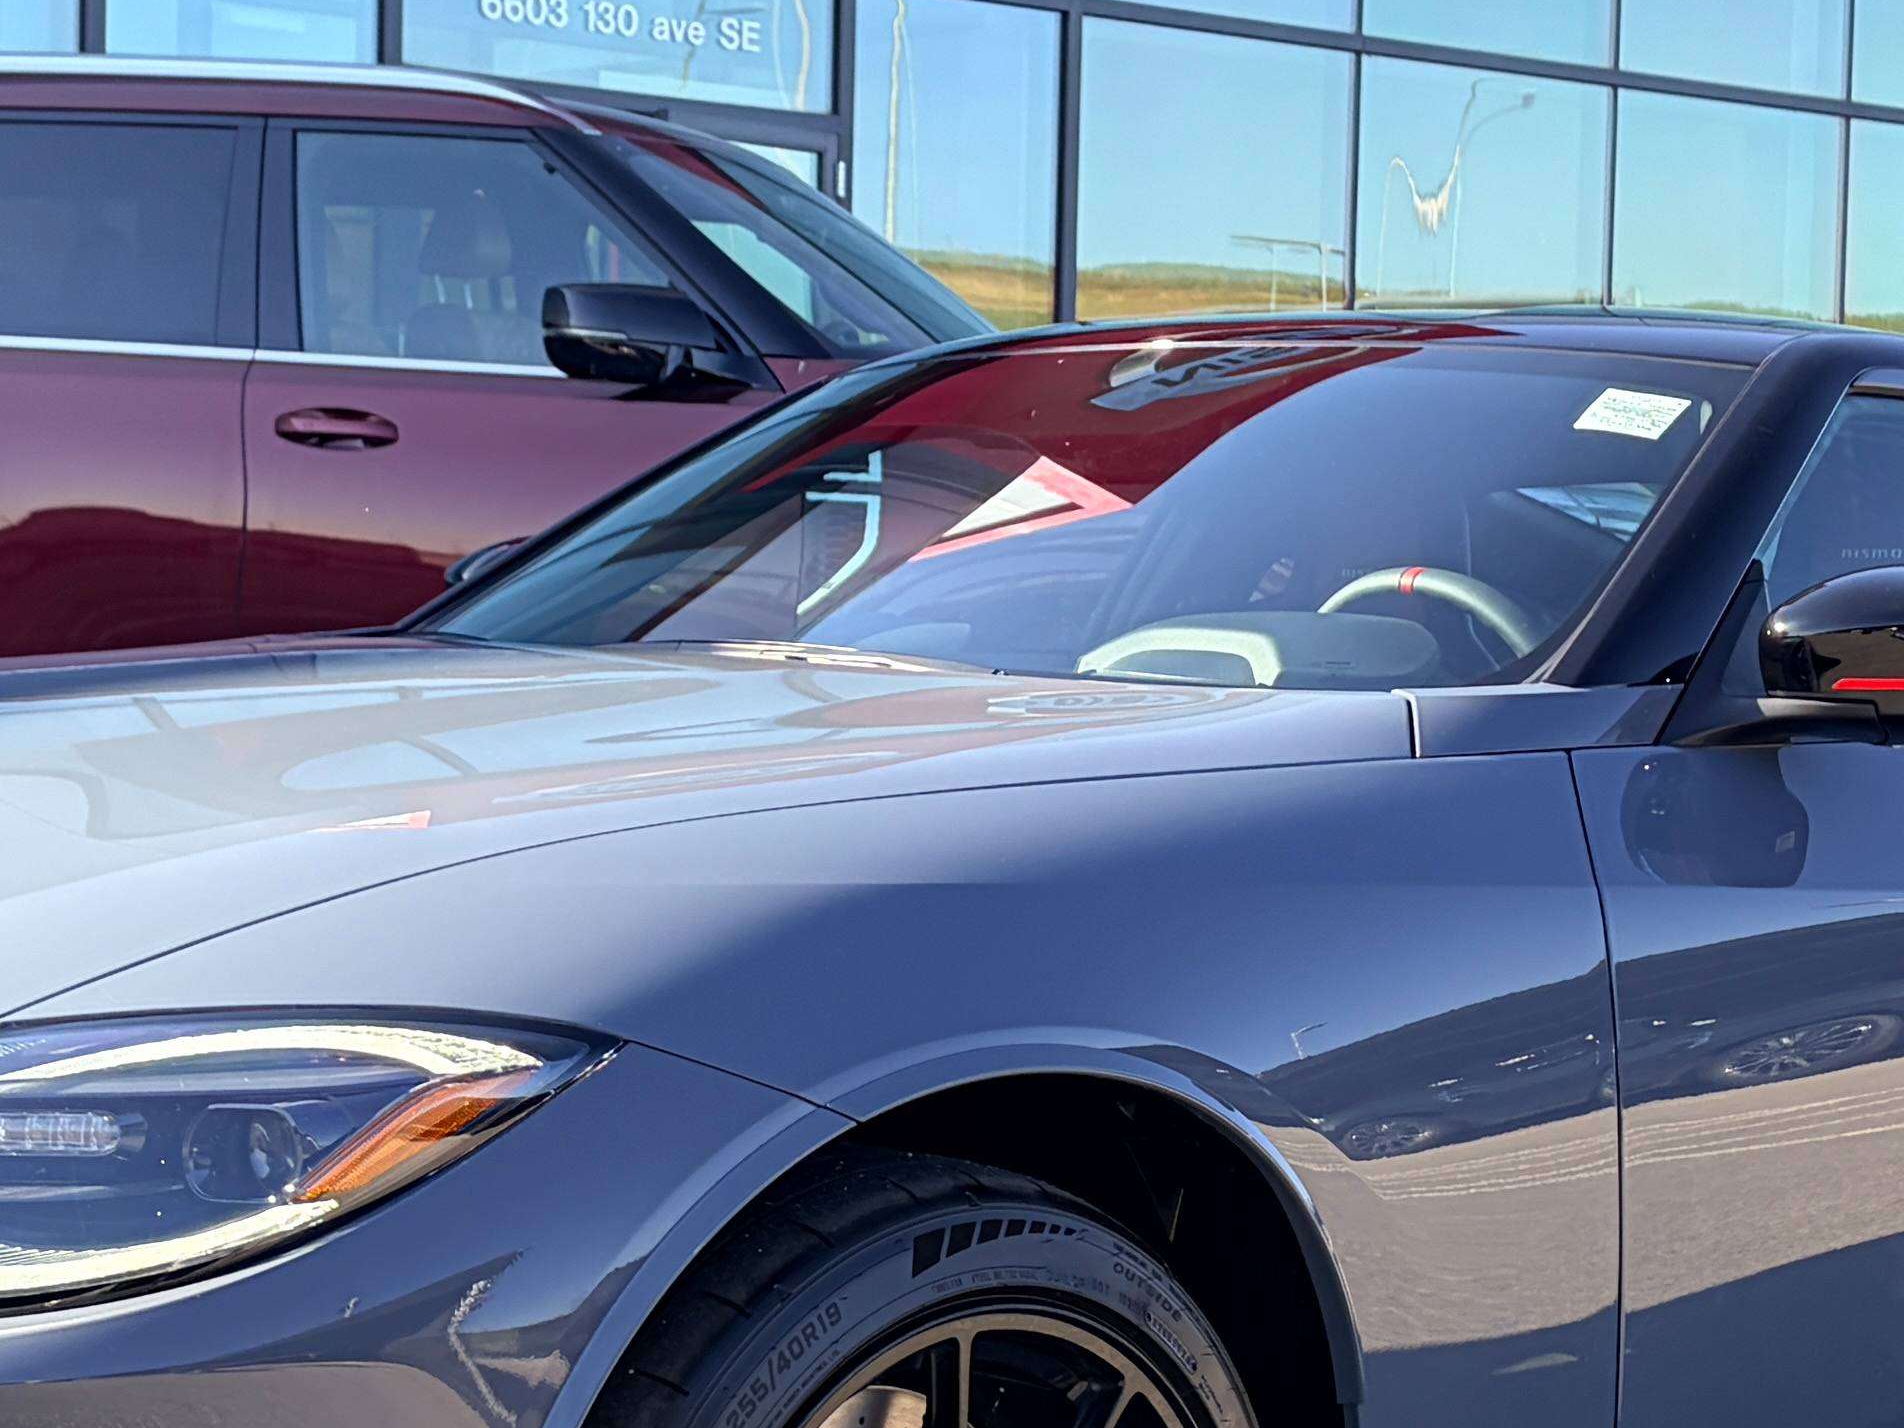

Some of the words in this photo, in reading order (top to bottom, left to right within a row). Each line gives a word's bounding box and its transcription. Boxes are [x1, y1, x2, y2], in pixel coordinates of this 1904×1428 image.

[582, 0, 639, 37] 130
[652, 16, 706, 46] ave
[718, 17, 762, 53] SE
